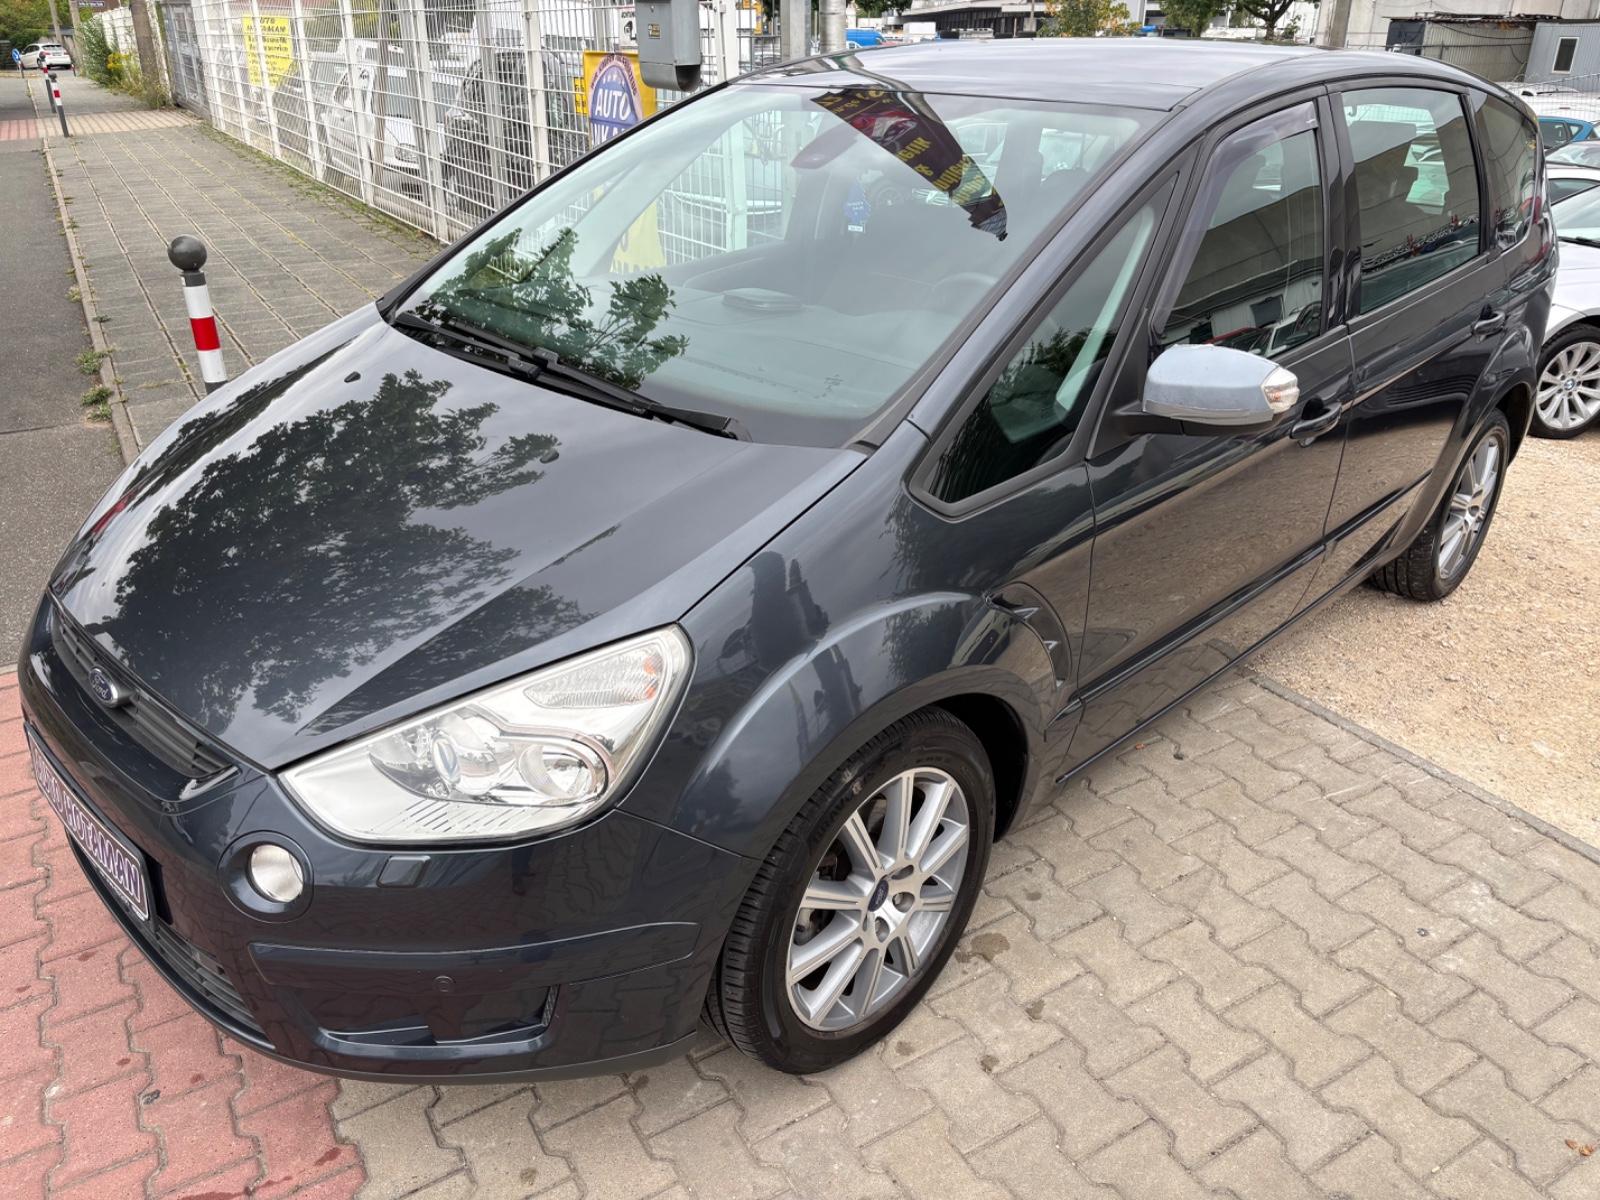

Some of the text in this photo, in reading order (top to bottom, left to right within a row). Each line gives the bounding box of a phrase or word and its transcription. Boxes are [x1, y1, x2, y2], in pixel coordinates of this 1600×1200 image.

[594, 88, 632, 120] AUTO
[92, 674, 109, 700] Ford
[62, 789, 142, 904] HOTAMAN
